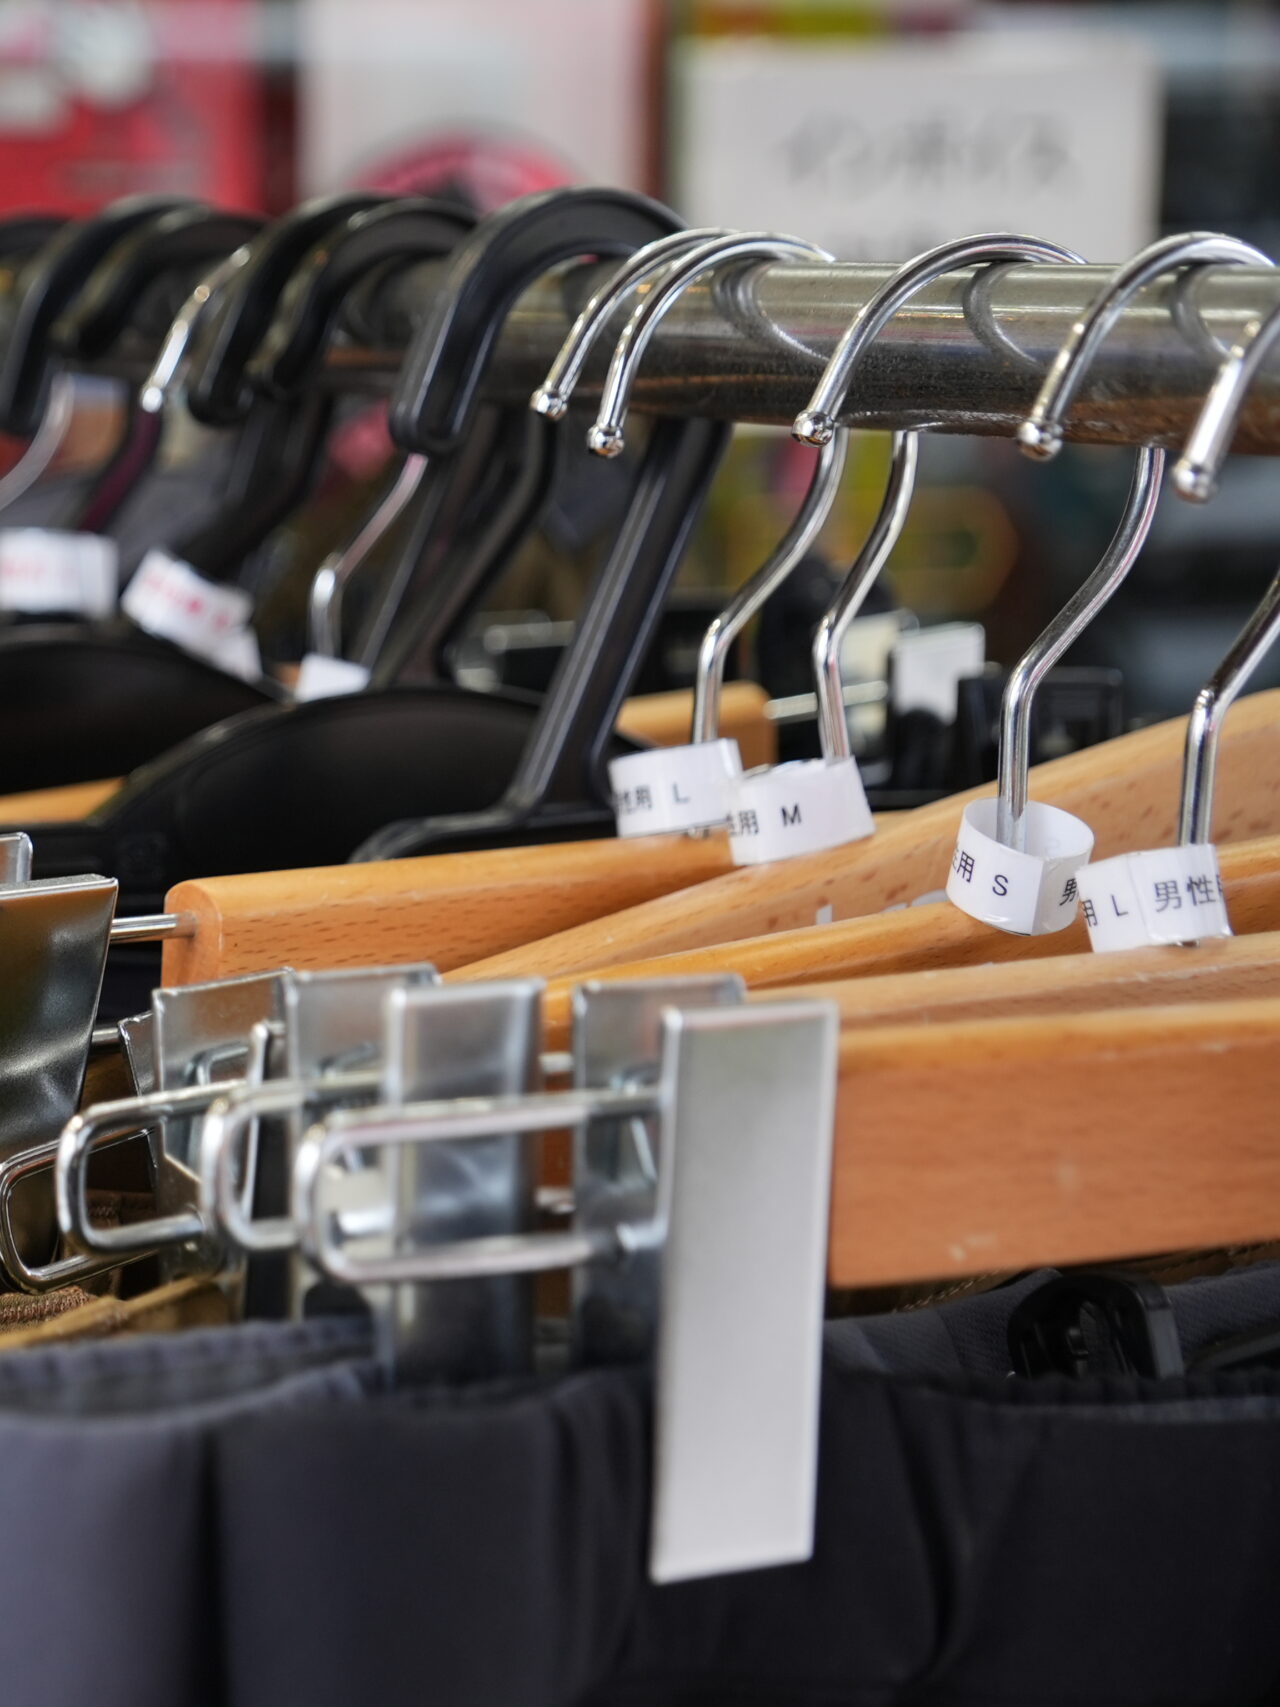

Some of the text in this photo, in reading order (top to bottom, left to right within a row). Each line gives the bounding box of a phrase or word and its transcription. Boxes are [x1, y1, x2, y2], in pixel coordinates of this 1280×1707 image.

[672, 782, 691, 803] L
[781, 803, 802, 827] M
[951, 846, 976, 883] 用
[992, 874, 1009, 897] S
[1110, 893, 1129, 916] L
[1154, 873, 1223, 912] 男性
